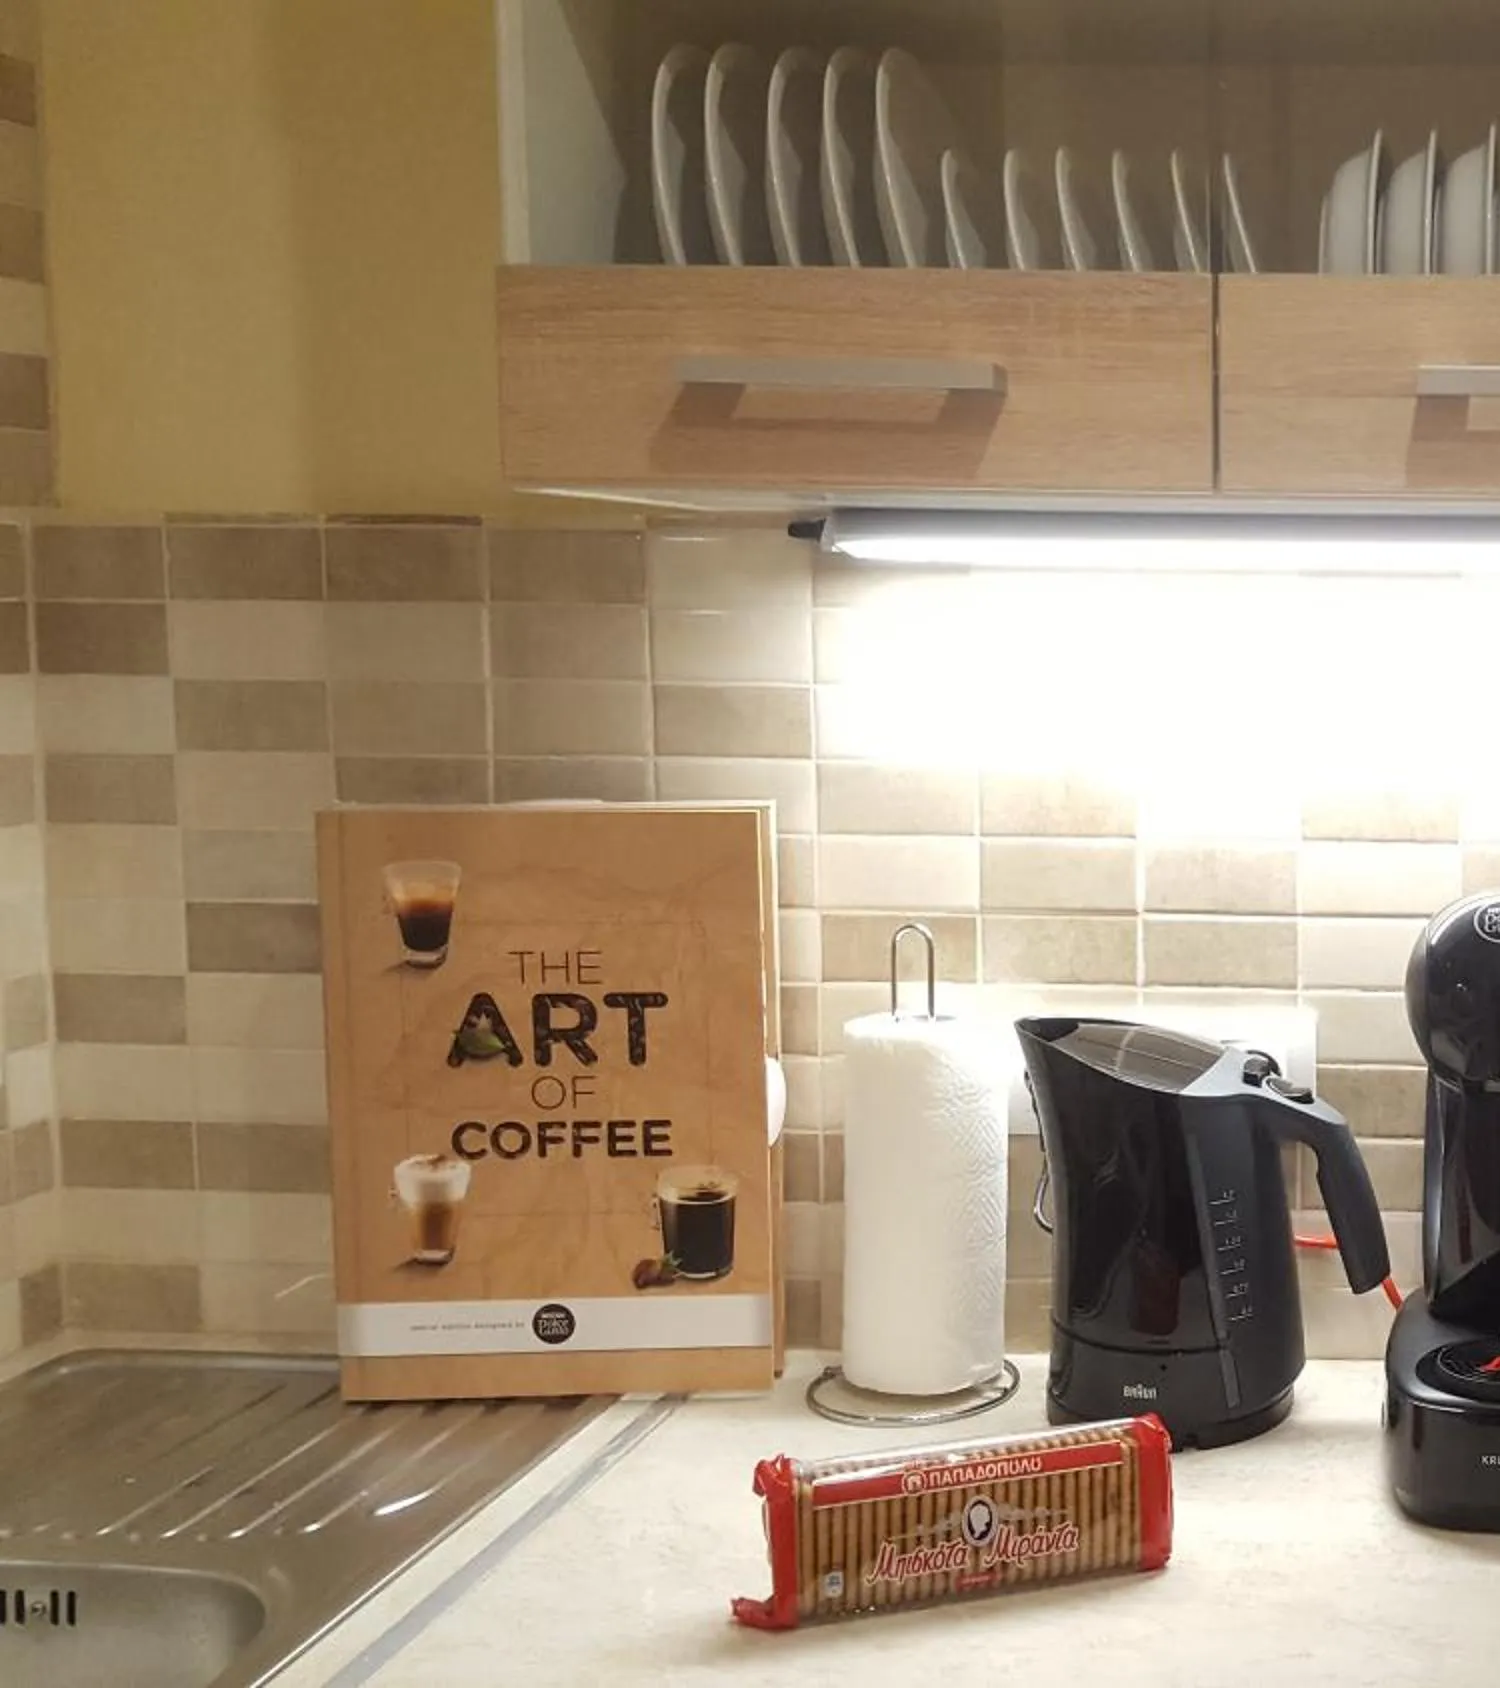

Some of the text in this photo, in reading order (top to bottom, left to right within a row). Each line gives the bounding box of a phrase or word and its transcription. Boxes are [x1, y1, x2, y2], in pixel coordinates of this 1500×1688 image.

[508, 950, 603, 985] THE
[446, 991, 669, 1068] ART
[531, 1074, 599, 1111] OF
[451, 1119, 673, 1160] COFFEE
